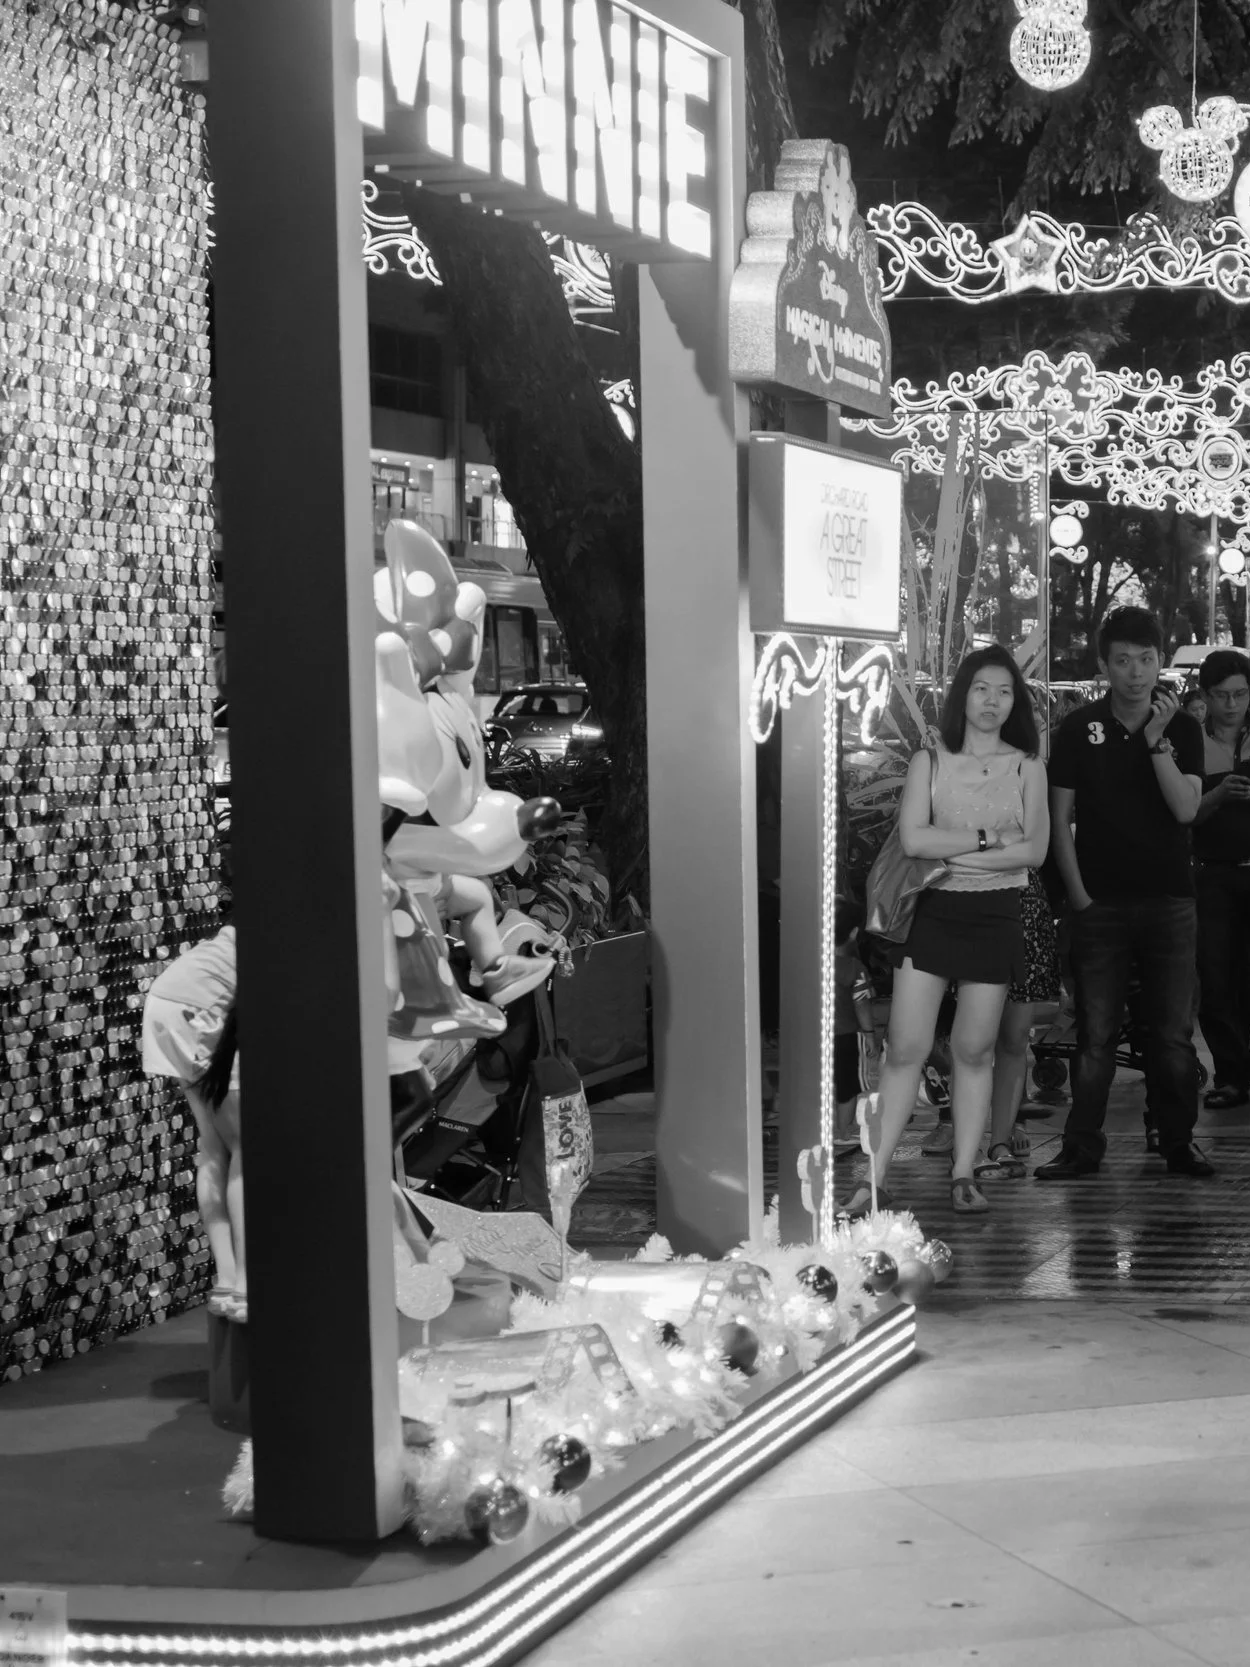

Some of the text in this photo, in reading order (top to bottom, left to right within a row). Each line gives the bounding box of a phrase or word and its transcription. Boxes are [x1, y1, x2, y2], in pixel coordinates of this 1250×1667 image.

[820, 511, 868, 556] A GREAT
[827, 556, 862, 599] STREET
[1087, 721, 1106, 745] 3
[438, 1121, 469, 1133] MACLAREN
[557, 1101, 575, 1160] LOVE
